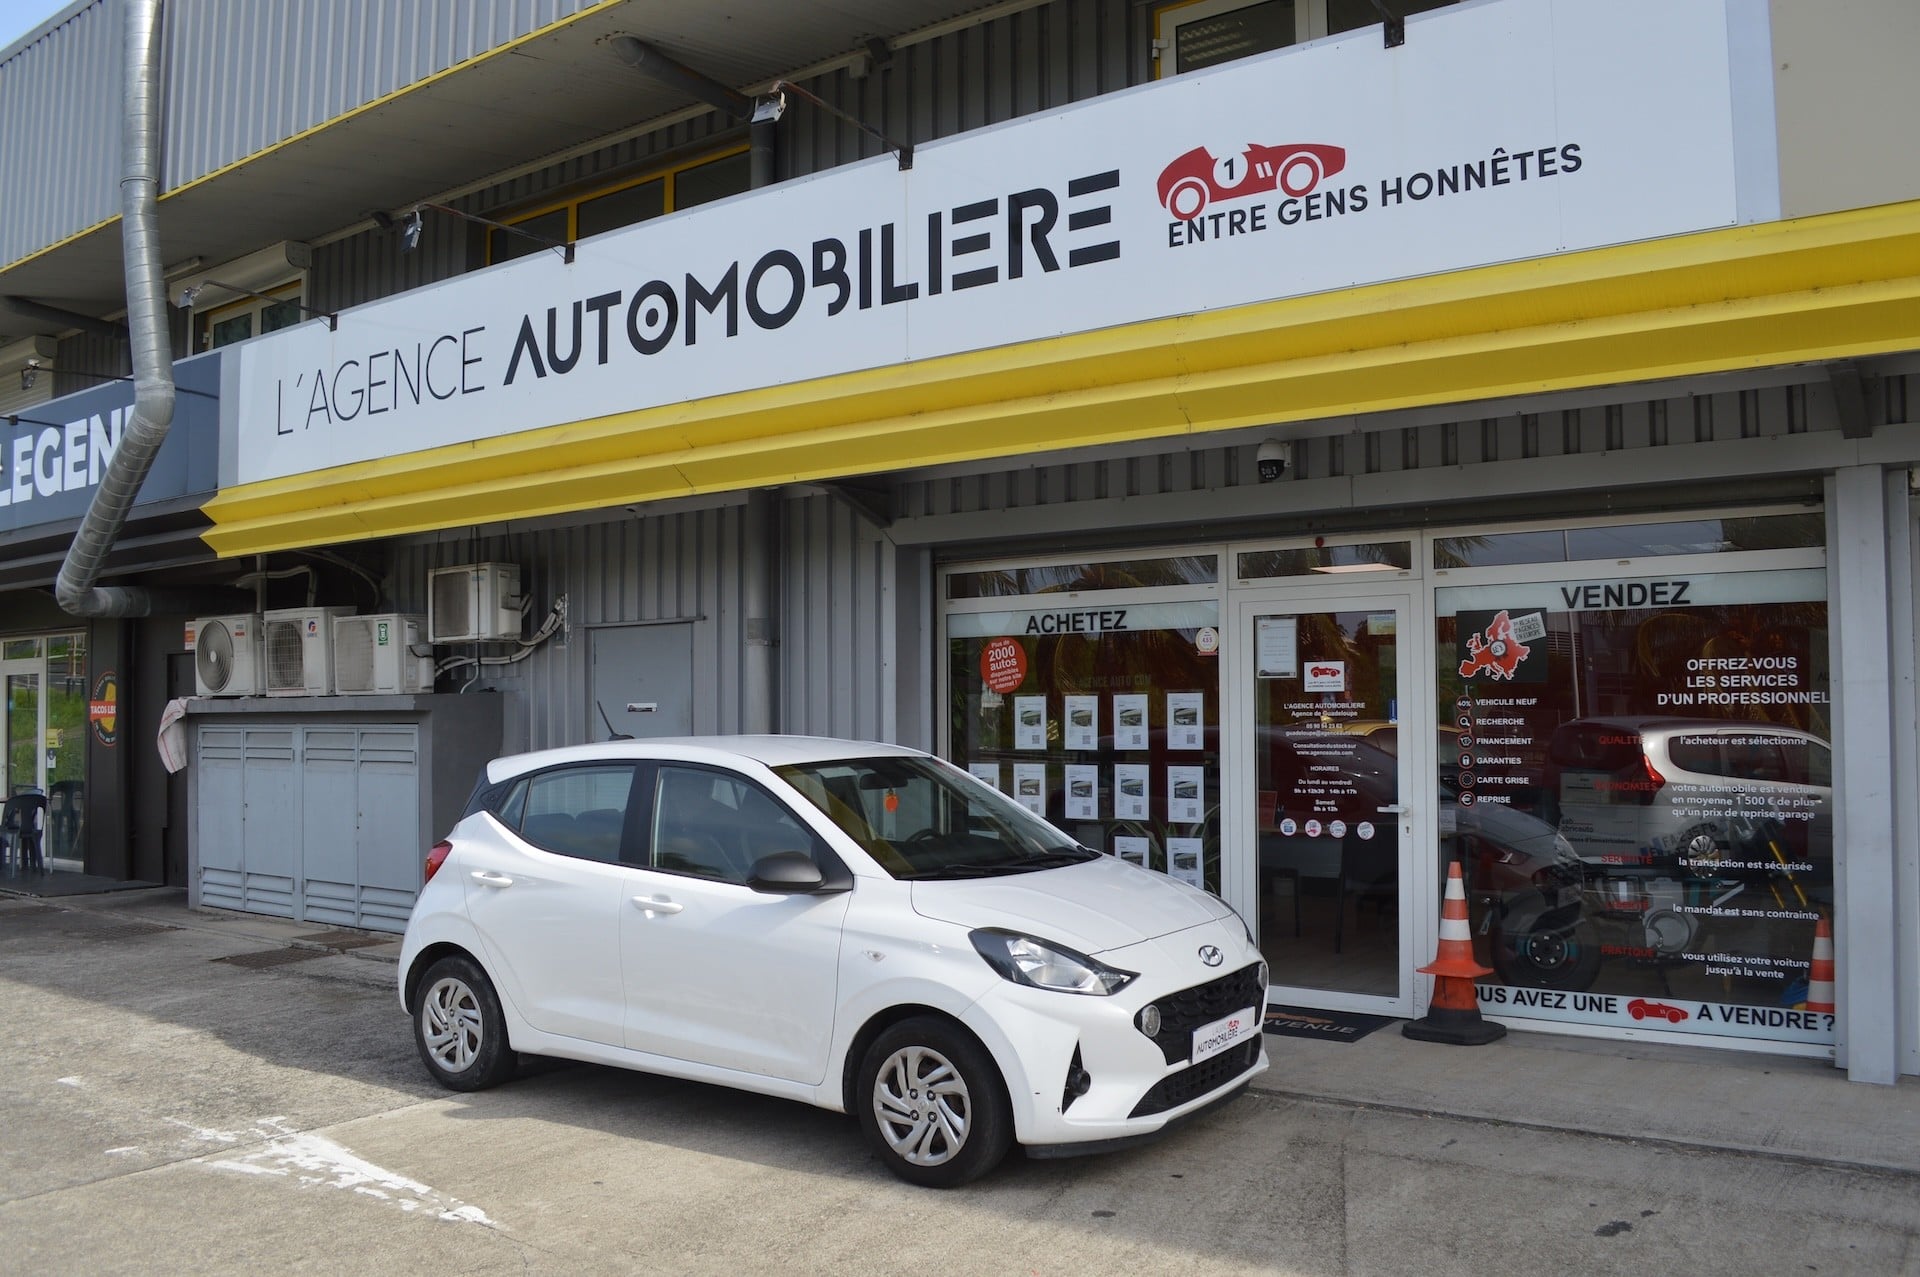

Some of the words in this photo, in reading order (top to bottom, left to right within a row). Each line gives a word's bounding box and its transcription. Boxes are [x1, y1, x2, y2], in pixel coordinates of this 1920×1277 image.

[1223, 157, 1235, 181] 1
[1169, 204, 1267, 248] ENTRE
[1278, 184, 1369, 227] GENS
[1381, 143, 1582, 207] HONNÊTES
[277, 326, 486, 436] L'AGENCE
[503, 169, 1121, 386] AUTOMOBILIERE
[0, 404, 136, 507] EGEN
[1561, 581, 1691, 609] VENDEZ
[1025, 610, 1128, 634] ACHETEZ
[988, 645, 1016, 662] 2000
[990, 658, 1017, 671] autos
[1686, 656, 1797, 671] OFFREZ-VOUS
[1687, 674, 1715, 688] LES
[1720, 673, 1798, 688] SERVICES
[1475, 697, 1513, 706] VEHICULE
[1515, 697, 1538, 706] NEUF
[1657, 692, 1695, 705] D'UN
[1698, 691, 1830, 705] PROFESSIONNEL
[91, 705, 107, 714] TACOS
[1284, 702, 1314, 710] L'AGENCE
[1291, 710, 1313, 718] Agence
[1322, 710, 1358, 718] Guadeloupe
[1476, 717, 1525, 726] RECHERCHE
[1476, 737, 1532, 746] FINANCEMENT
[1680, 735, 1730, 745] l'acheteur
[1476, 756, 1522, 765] GARANTIES
[1477, 776, 1504, 785] CARTE
[1505, 776, 1530, 785] GRISE
[1671, 784, 1697, 792] votre
[1699, 783, 1758, 793] automobile
[1760, 785, 1775, 793] est
[1477, 795, 1511, 804] REPRISE
[1686, 797, 1733, 807] moyenne
[1767, 797, 1775, 806] €
[1776, 797, 1791, 806] de
[1793, 798, 1815, 808] plus
[1672, 808, 1700, 818] qu'un
[1702, 808, 1723, 818] prix
[1724, 808, 1738, 817] de
[1740, 809, 1776, 820] reprise
[1778, 811, 1815, 821] garage
[1678, 857, 1687, 867] la
[1689, 857, 1745, 870] transaction
[1747, 860, 1762, 870] est
[1765, 859, 1813, 872] sécurisée
[1672, 904, 1682, 913] le
[1684, 905, 1722, 915] mandat
[1724, 907, 1739, 916] est
[1742, 909, 1764, 918] sans
[1767, 909, 1819, 921] contrainte
[1682, 953, 1705, 961] vous
[1707, 952, 1743, 964] utilisez
[1745, 956, 1772, 965] votre
[1774, 957, 1810, 968] voiture
[1705, 965, 1742, 978] jusqu'à
[1744, 967, 1753, 977] la
[1756, 969, 1785, 979] vente
[1513, 989, 1567, 1009] AVEZ
[1574, 994, 1618, 1014] UNE
[1697, 1004, 1713, 1021] A
[1719, 1005, 1818, 1031] VENDRE
